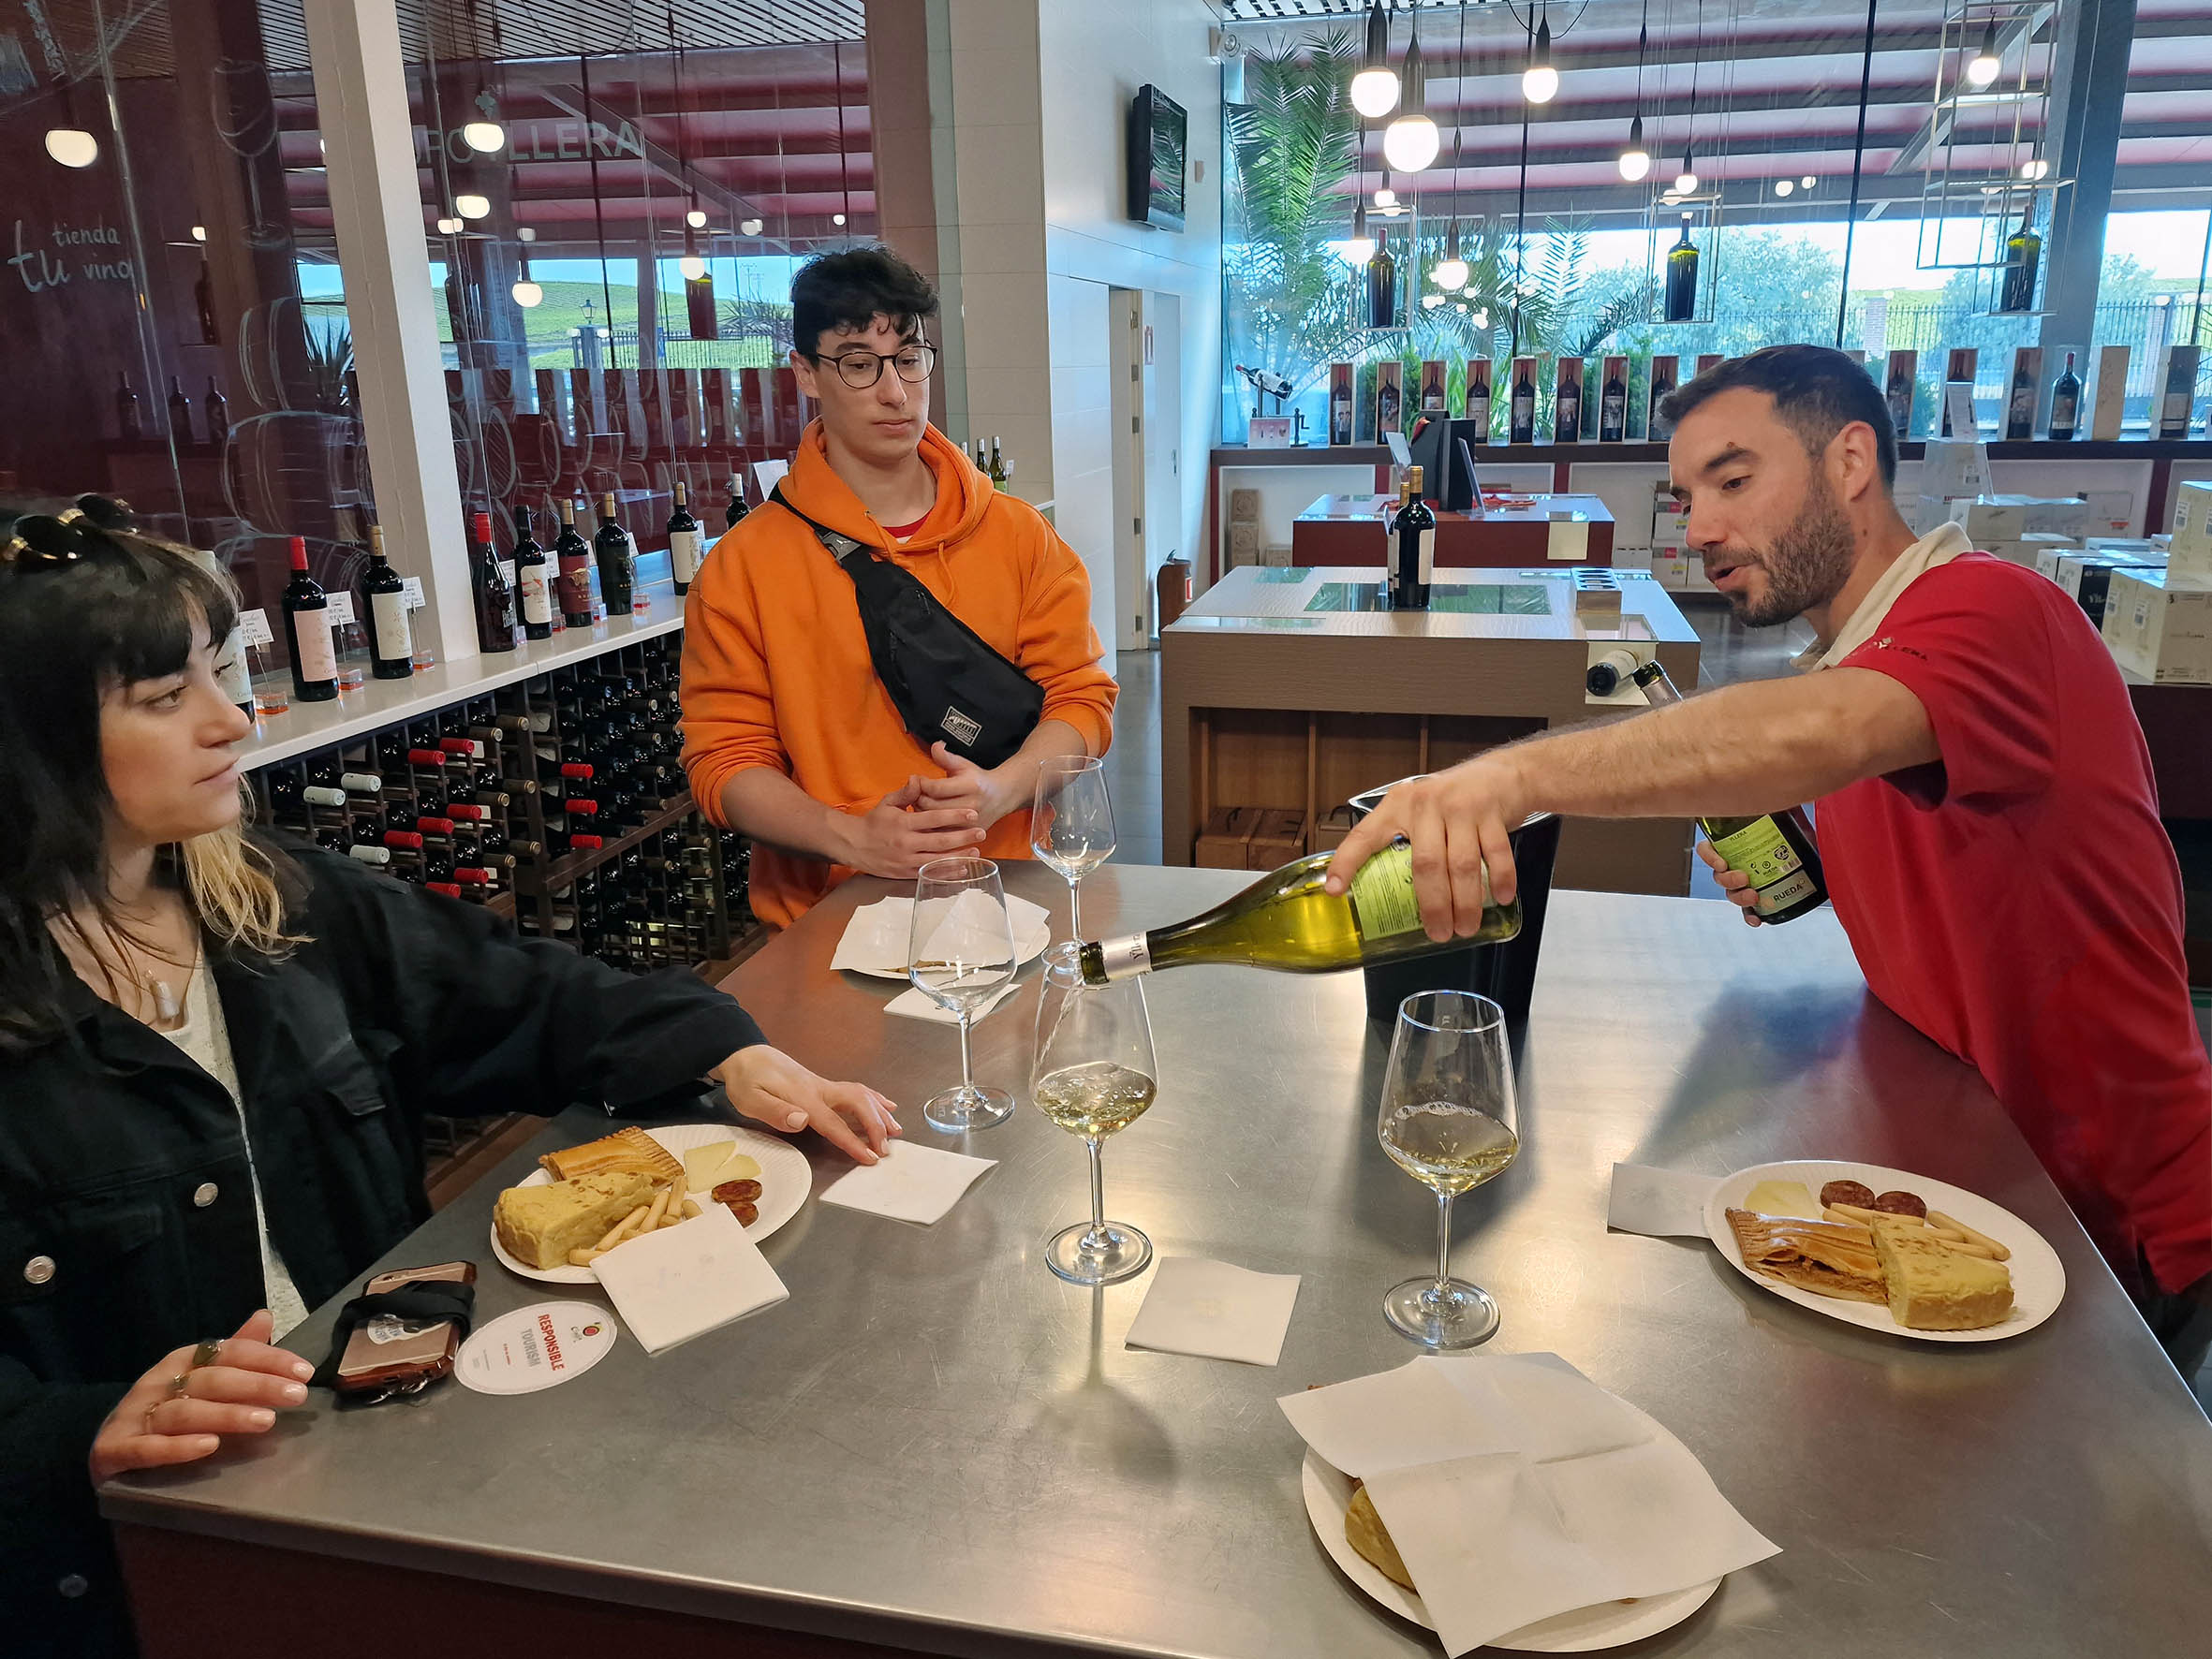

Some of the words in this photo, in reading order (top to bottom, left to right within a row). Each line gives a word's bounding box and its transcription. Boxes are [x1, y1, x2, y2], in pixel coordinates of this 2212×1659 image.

[485, 121, 644, 162] LLERA
[52, 214, 120, 247] tienda
[82, 253, 134, 280] vino
[1773, 883, 1804, 902] RUEDA
[521, 1328, 542, 1367] TOURISM
[538, 1313, 565, 1371] RESPONSIBLE
